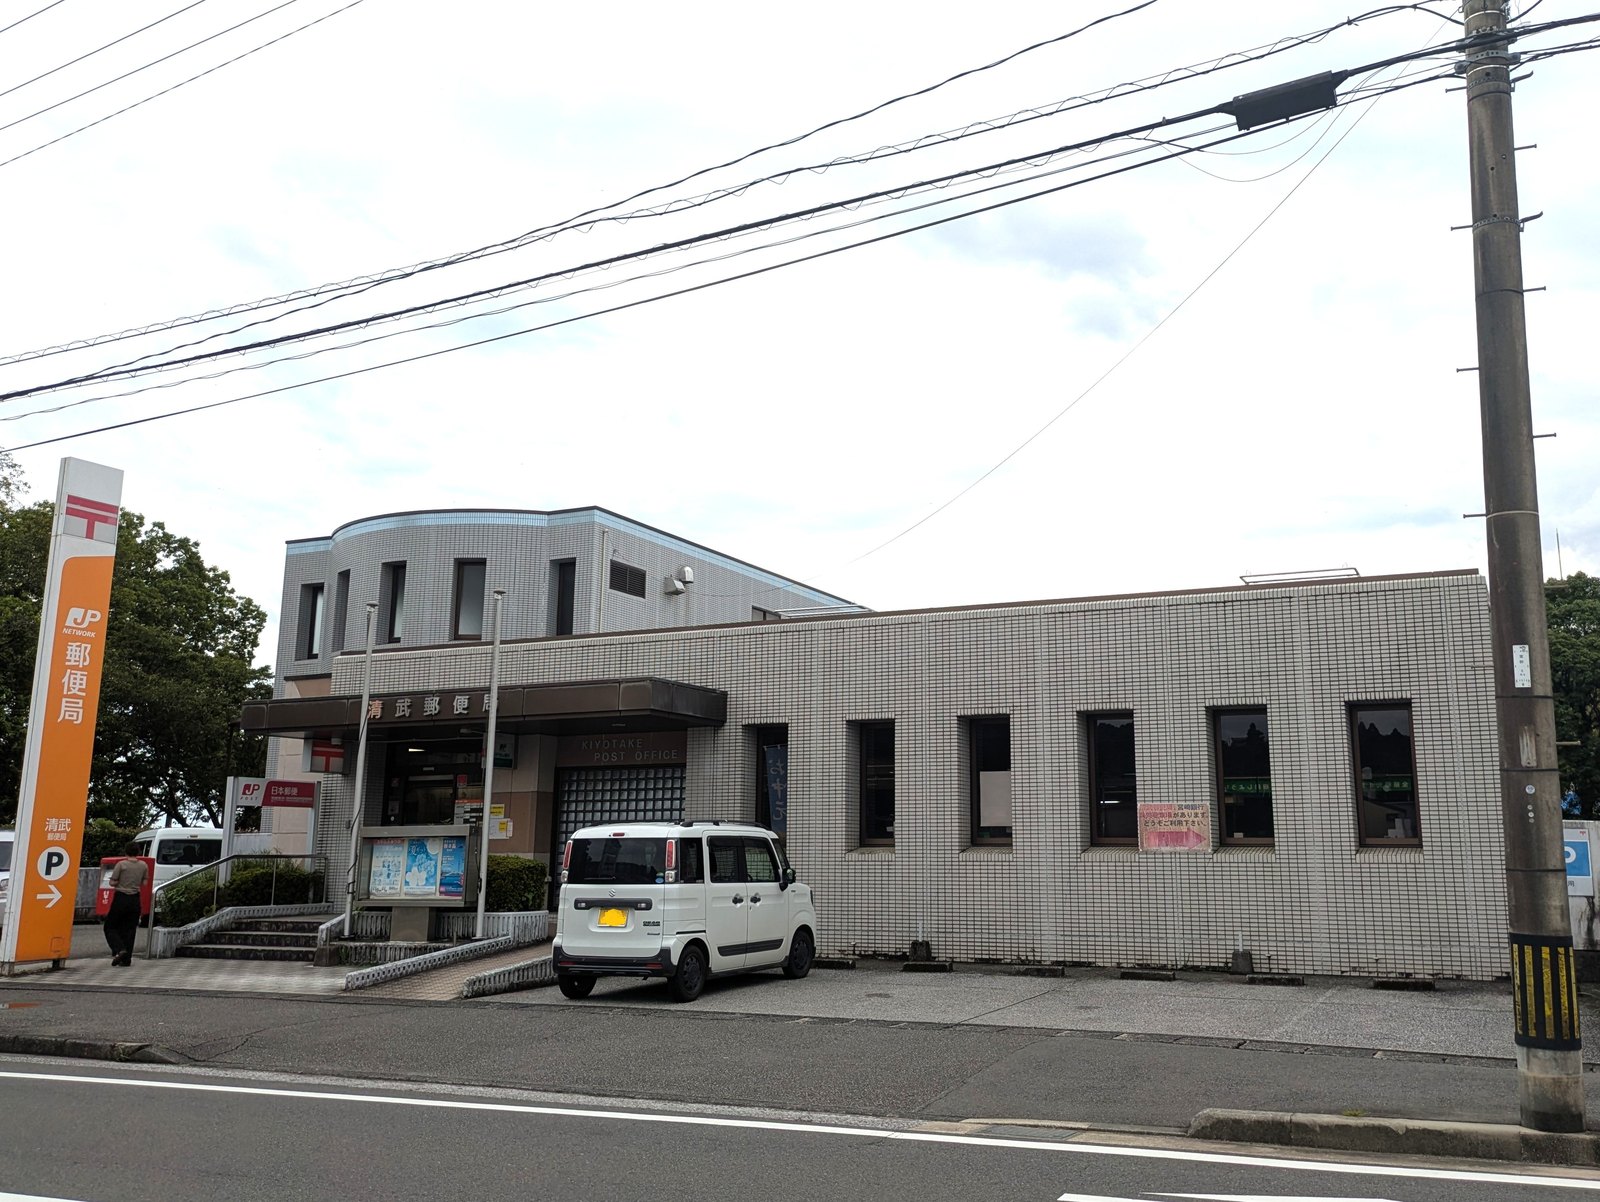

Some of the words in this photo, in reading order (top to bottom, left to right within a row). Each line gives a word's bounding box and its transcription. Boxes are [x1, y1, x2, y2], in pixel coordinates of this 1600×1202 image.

[64, 607, 102, 629] JP
[62, 627, 96, 638] NETWORK
[57, 642, 92, 724] 郵便局
[582, 738, 643, 750] KIYOTAKE
[594, 751, 625, 761] POST
[635, 749, 678, 761] OFFICE
[242, 784, 260, 796] JP
[271, 786, 298, 796] 日本郵便
[44, 817, 72, 832] 清武
[45, 851, 64, 876] P
